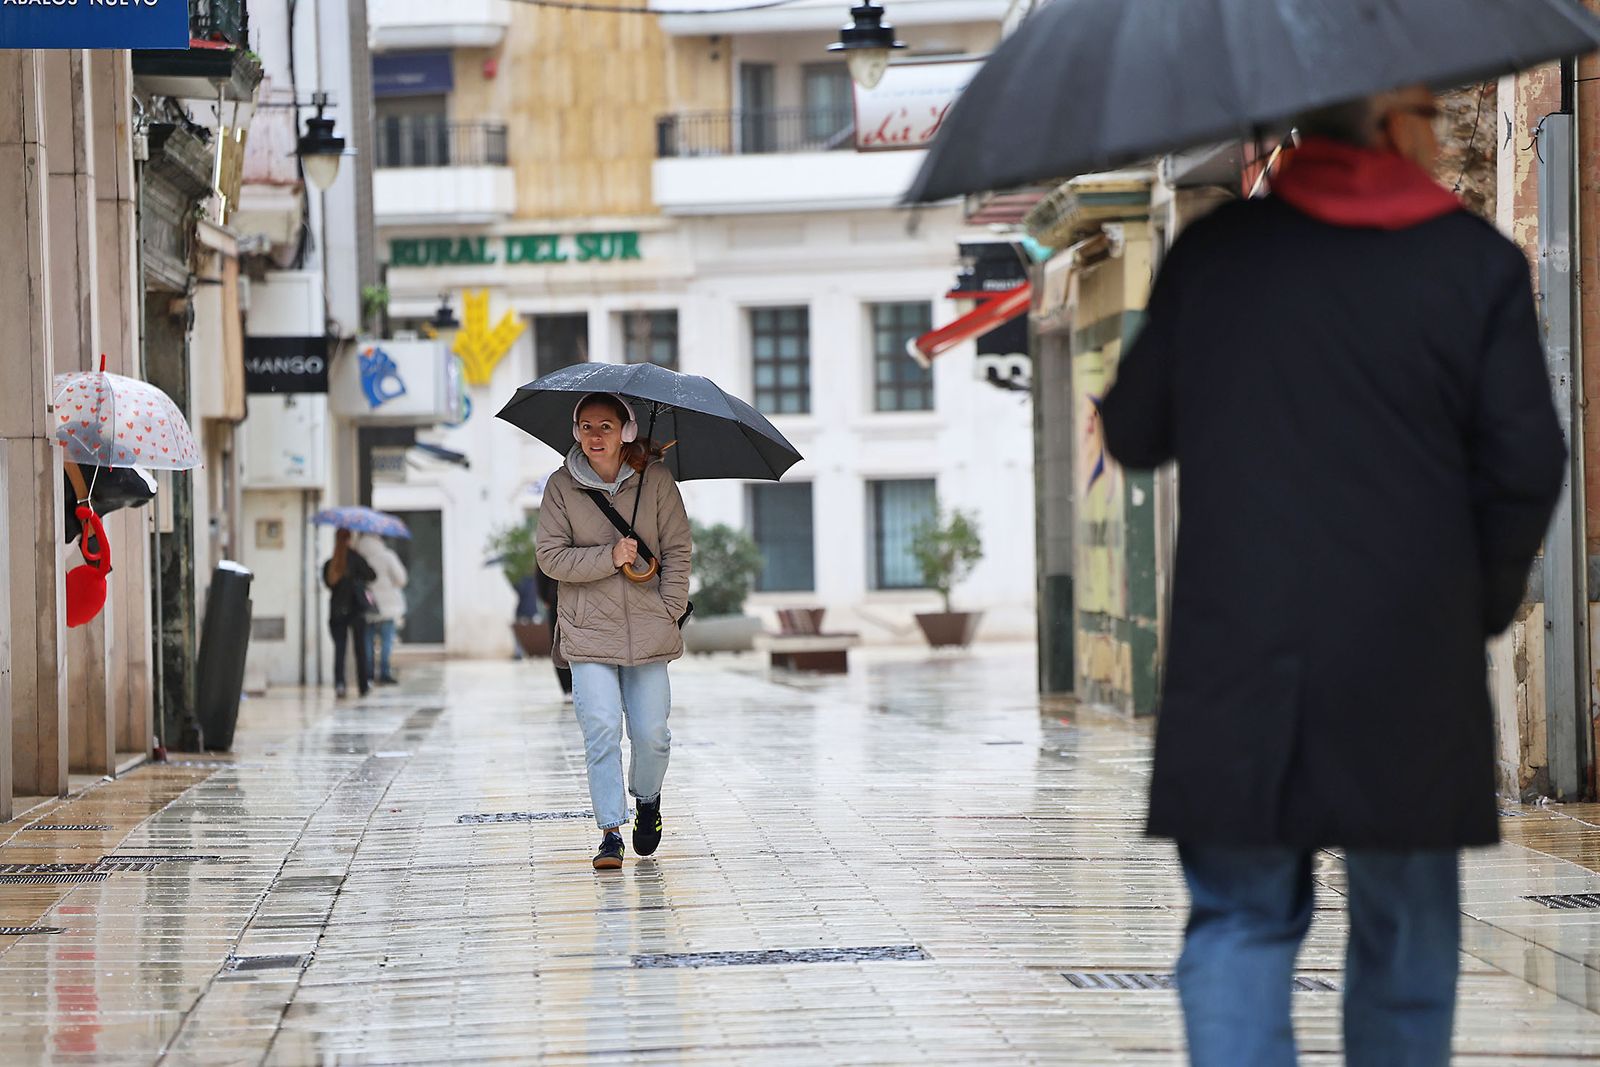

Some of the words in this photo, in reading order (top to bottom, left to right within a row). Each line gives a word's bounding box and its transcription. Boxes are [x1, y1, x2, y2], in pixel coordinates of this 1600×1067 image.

[389, 236, 496, 266] RURAL
[504, 234, 568, 263] DEL
[575, 232, 641, 262] SUR
